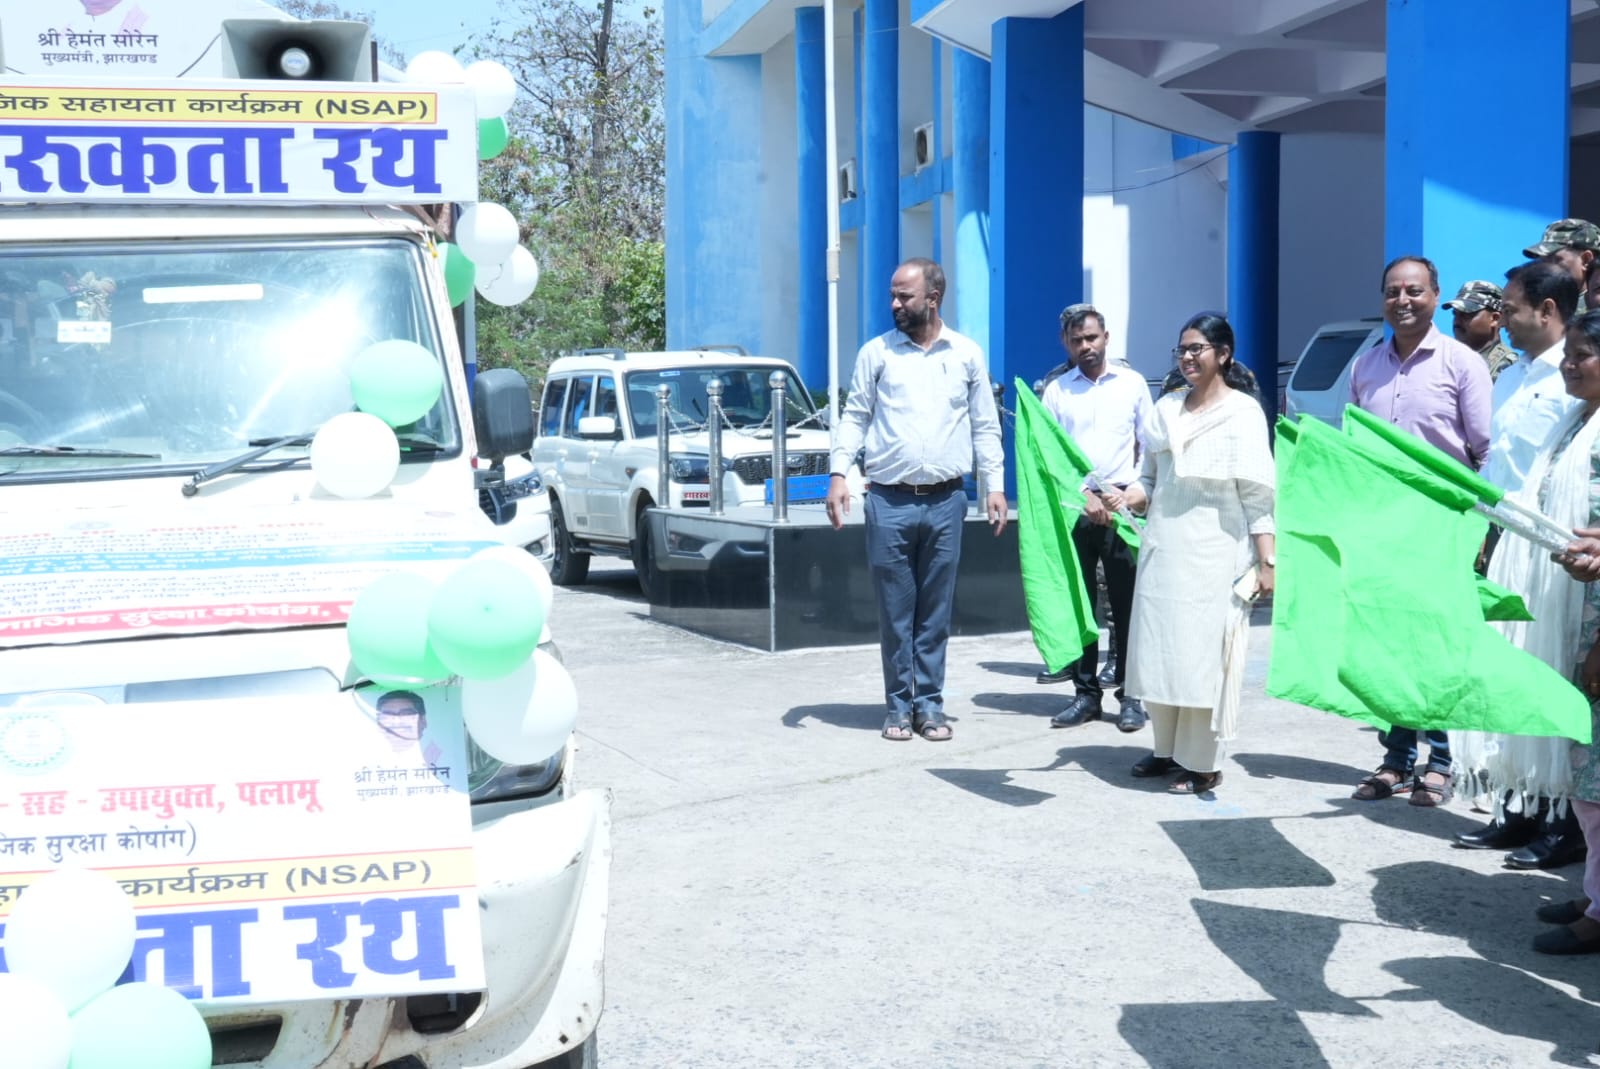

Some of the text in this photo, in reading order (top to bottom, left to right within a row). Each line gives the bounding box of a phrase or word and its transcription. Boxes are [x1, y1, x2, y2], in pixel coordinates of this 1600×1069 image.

[38, 28, 159, 49] श्री हेमंत सोरेन
[59, 96, 176, 114] सहायता
[187, 93, 303, 116] कार्यक्रम
[315, 97, 429, 120] (NSAP)
[313, 127, 448, 194] रथ
[19, 790, 70, 816] सह
[235, 779, 324, 813] पलामू
[45, 833, 108, 863] सुरक्षा
[116, 820, 197, 857] कोषांग)
[116, 859, 432, 898] कार्यक्रम (NSAP)
[283, 895, 460, 989] रथ
